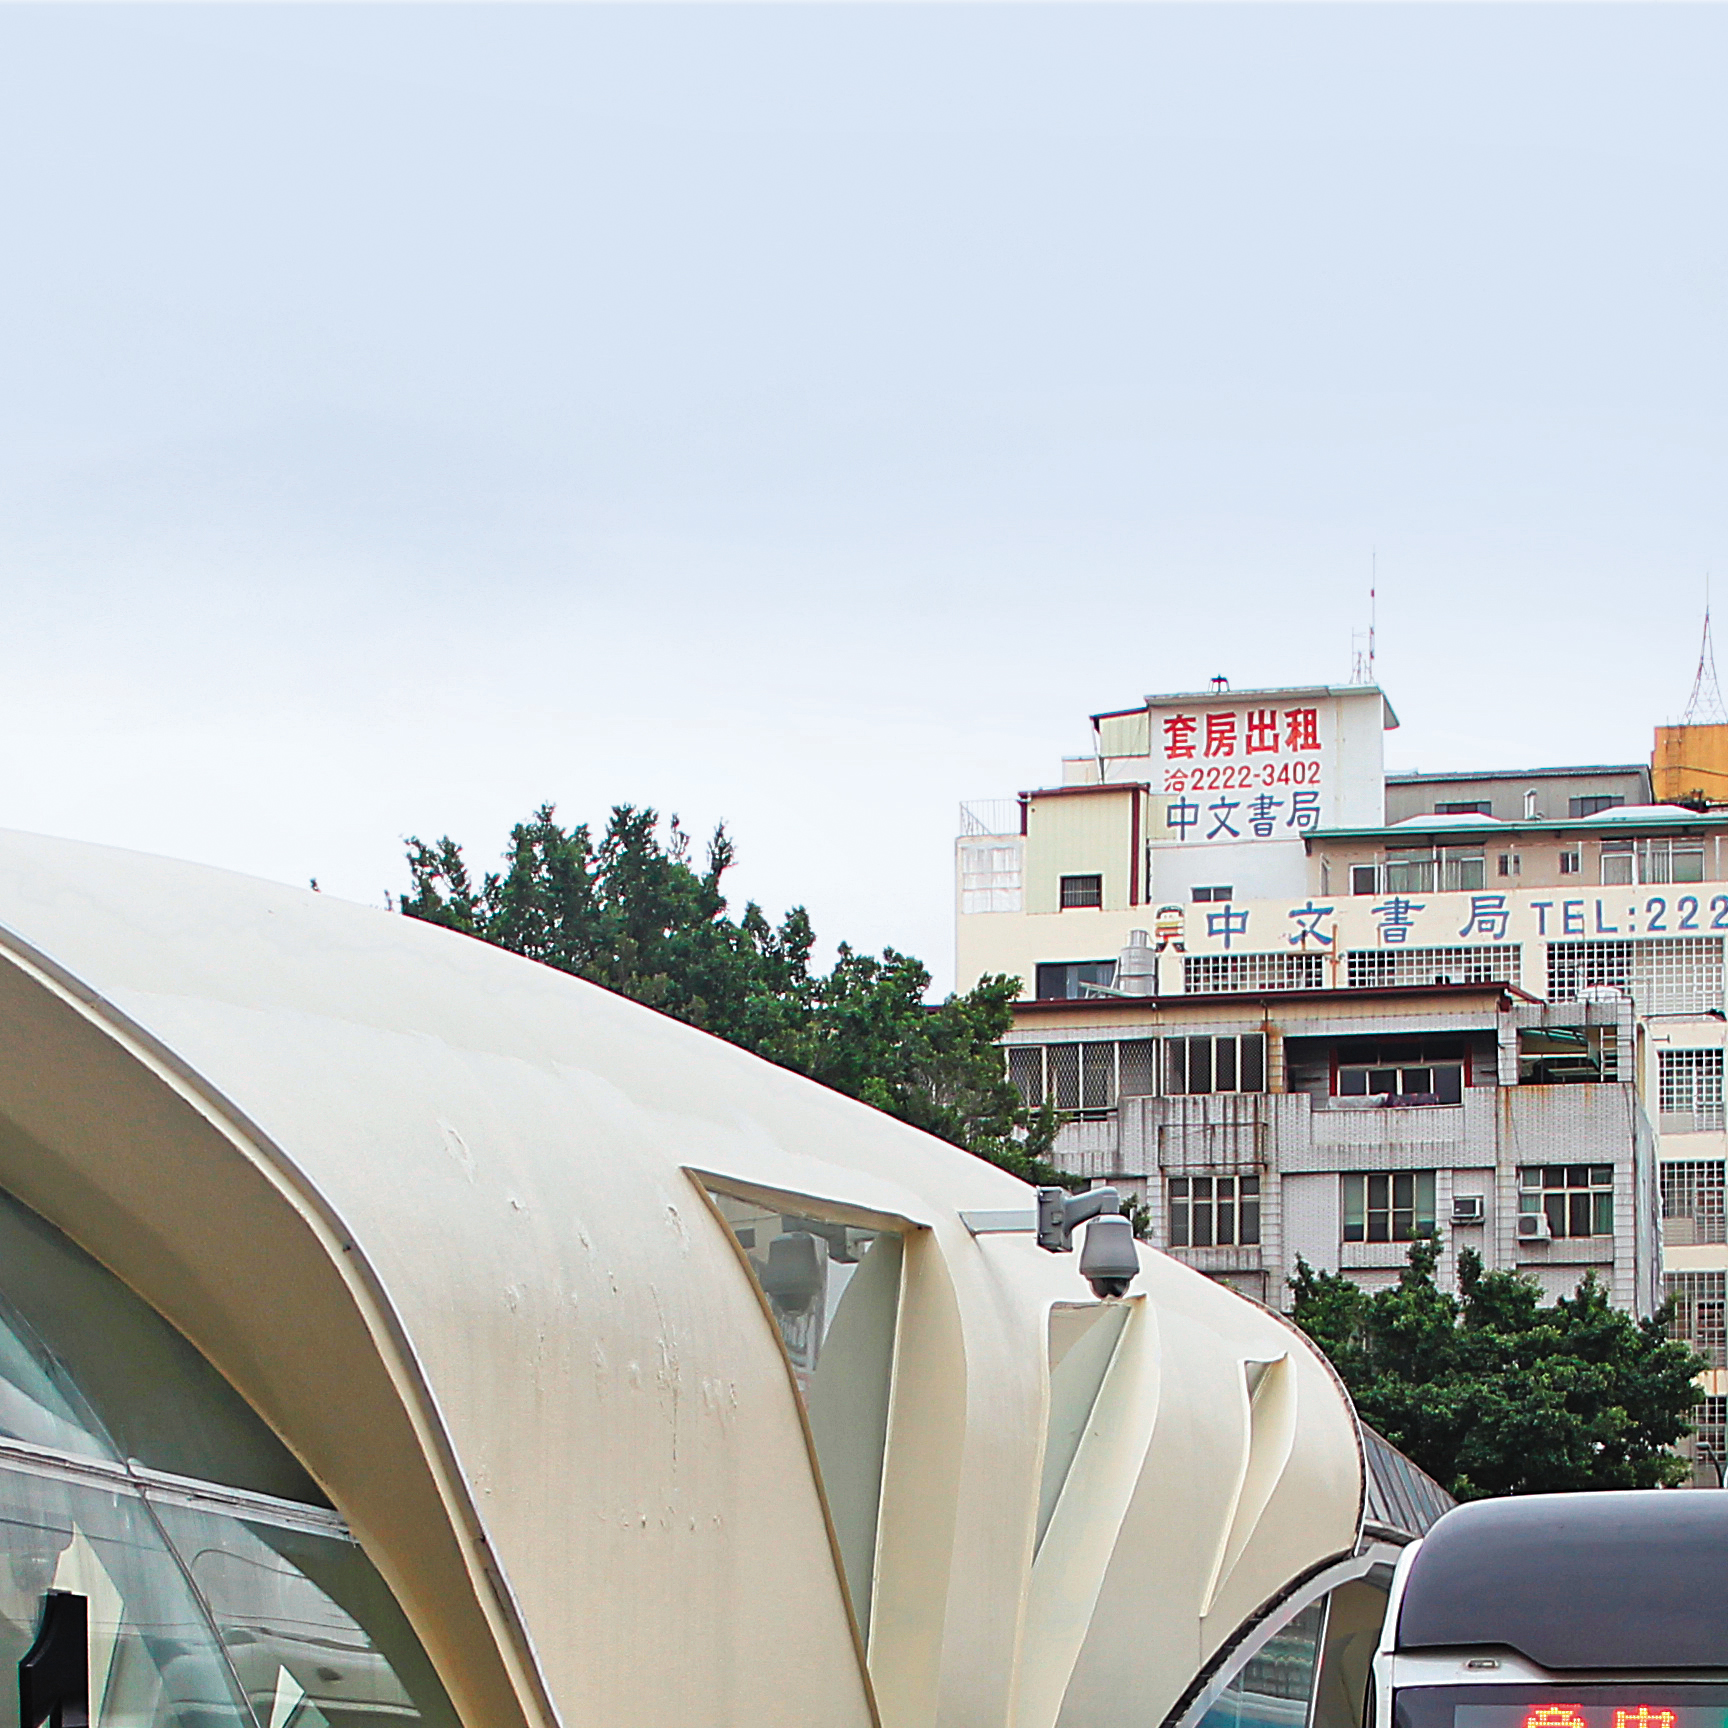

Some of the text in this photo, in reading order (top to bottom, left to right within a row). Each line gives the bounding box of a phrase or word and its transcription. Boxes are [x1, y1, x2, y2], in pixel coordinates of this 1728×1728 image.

[1163, 707, 1322, 760] 套房出租
[1164, 761, 1321, 792] 洽2222-3402
[1166, 791, 1321, 841] 中文書局
[1206, 895, 1510, 950] 中文書局
